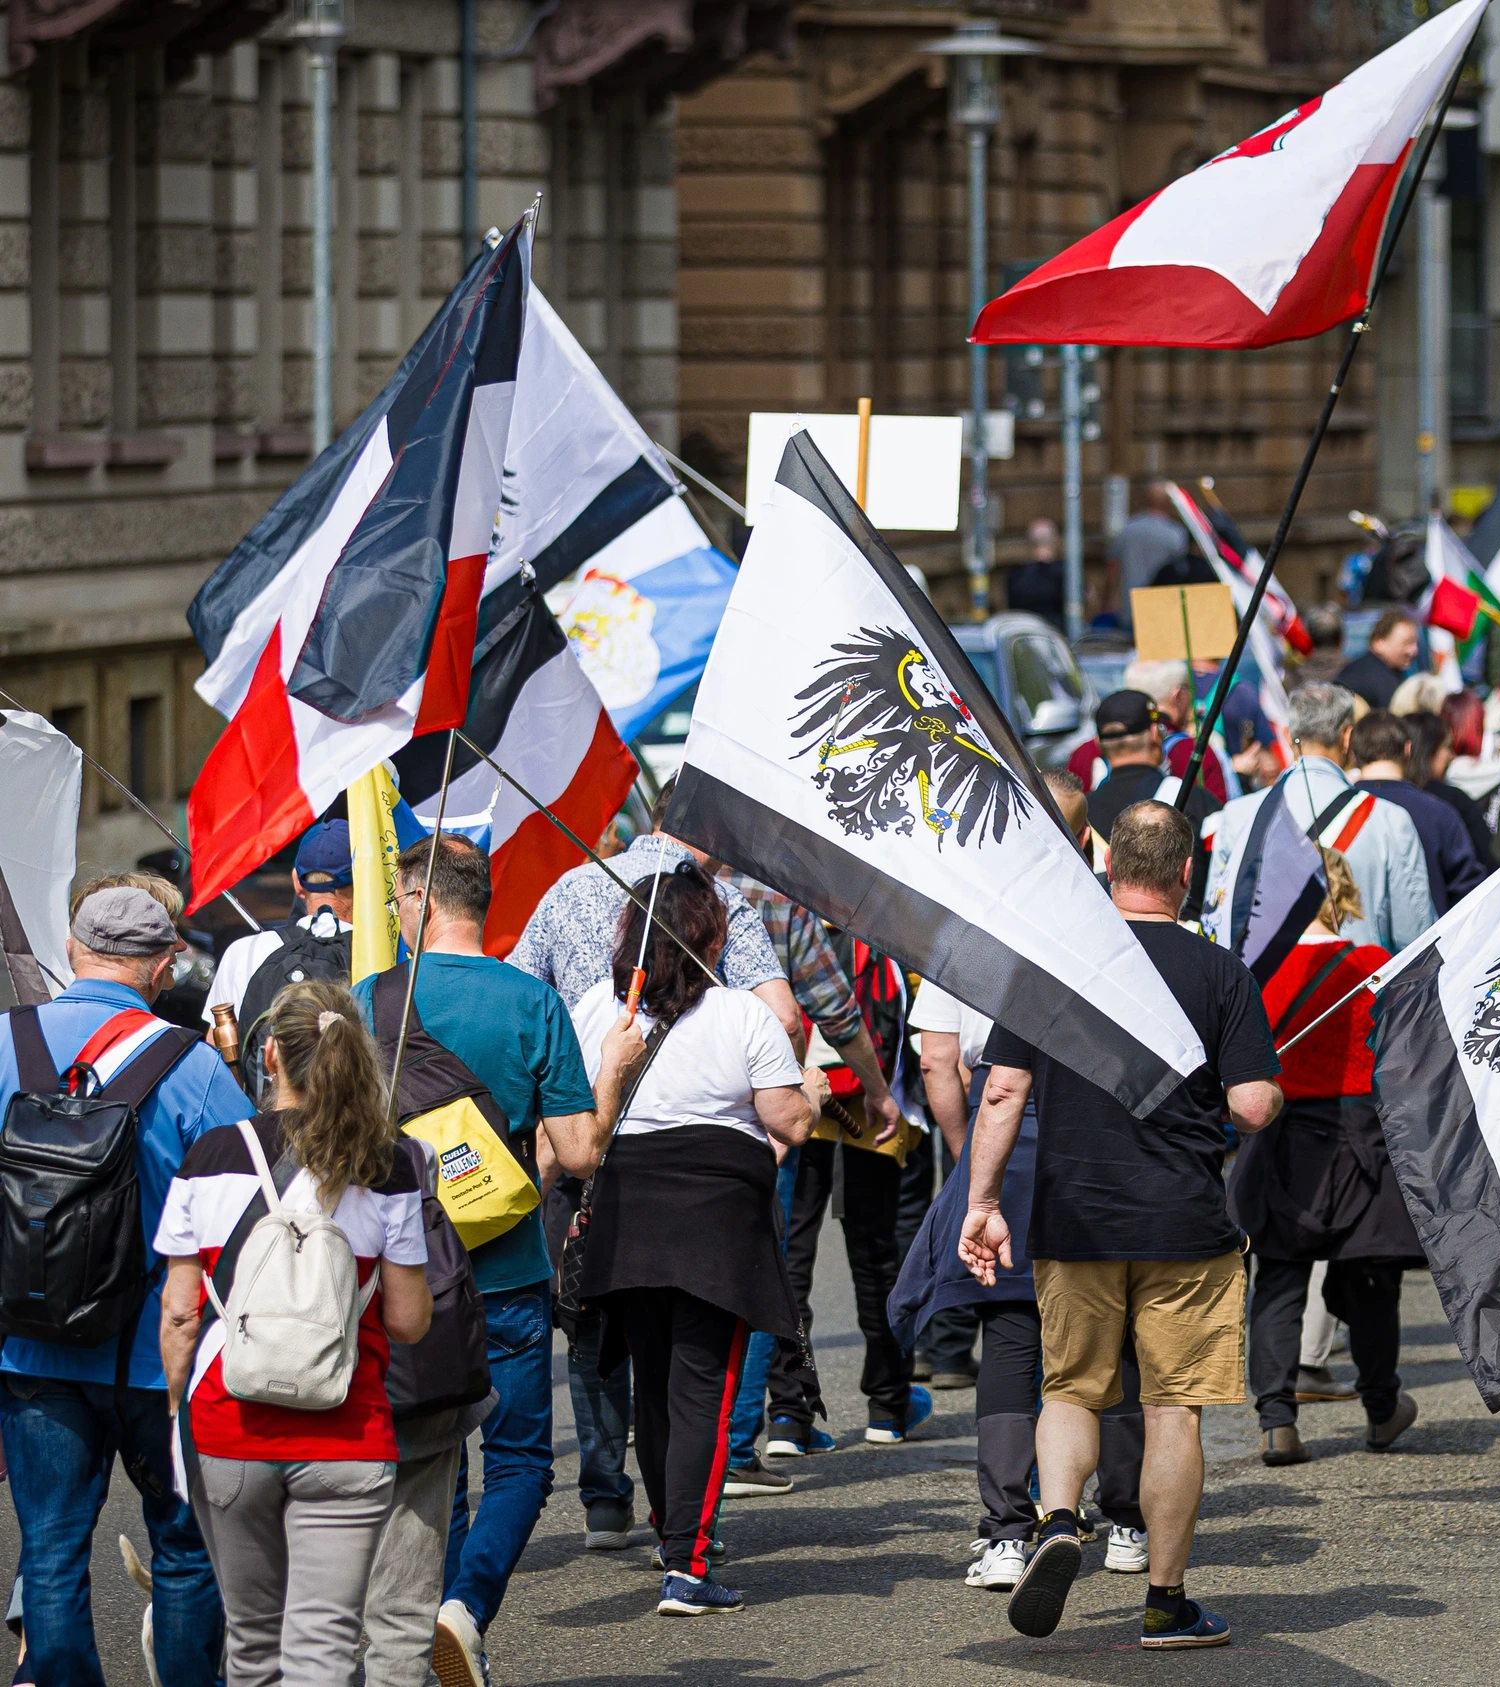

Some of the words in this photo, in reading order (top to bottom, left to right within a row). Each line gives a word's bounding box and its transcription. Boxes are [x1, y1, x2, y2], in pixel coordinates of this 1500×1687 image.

[442, 1145, 468, 1162] QUELLE
[440, 1150, 482, 1180] CHALLENGE
[451, 1187, 473, 1201] Deutsche
[472, 1182, 483, 1190] Post
